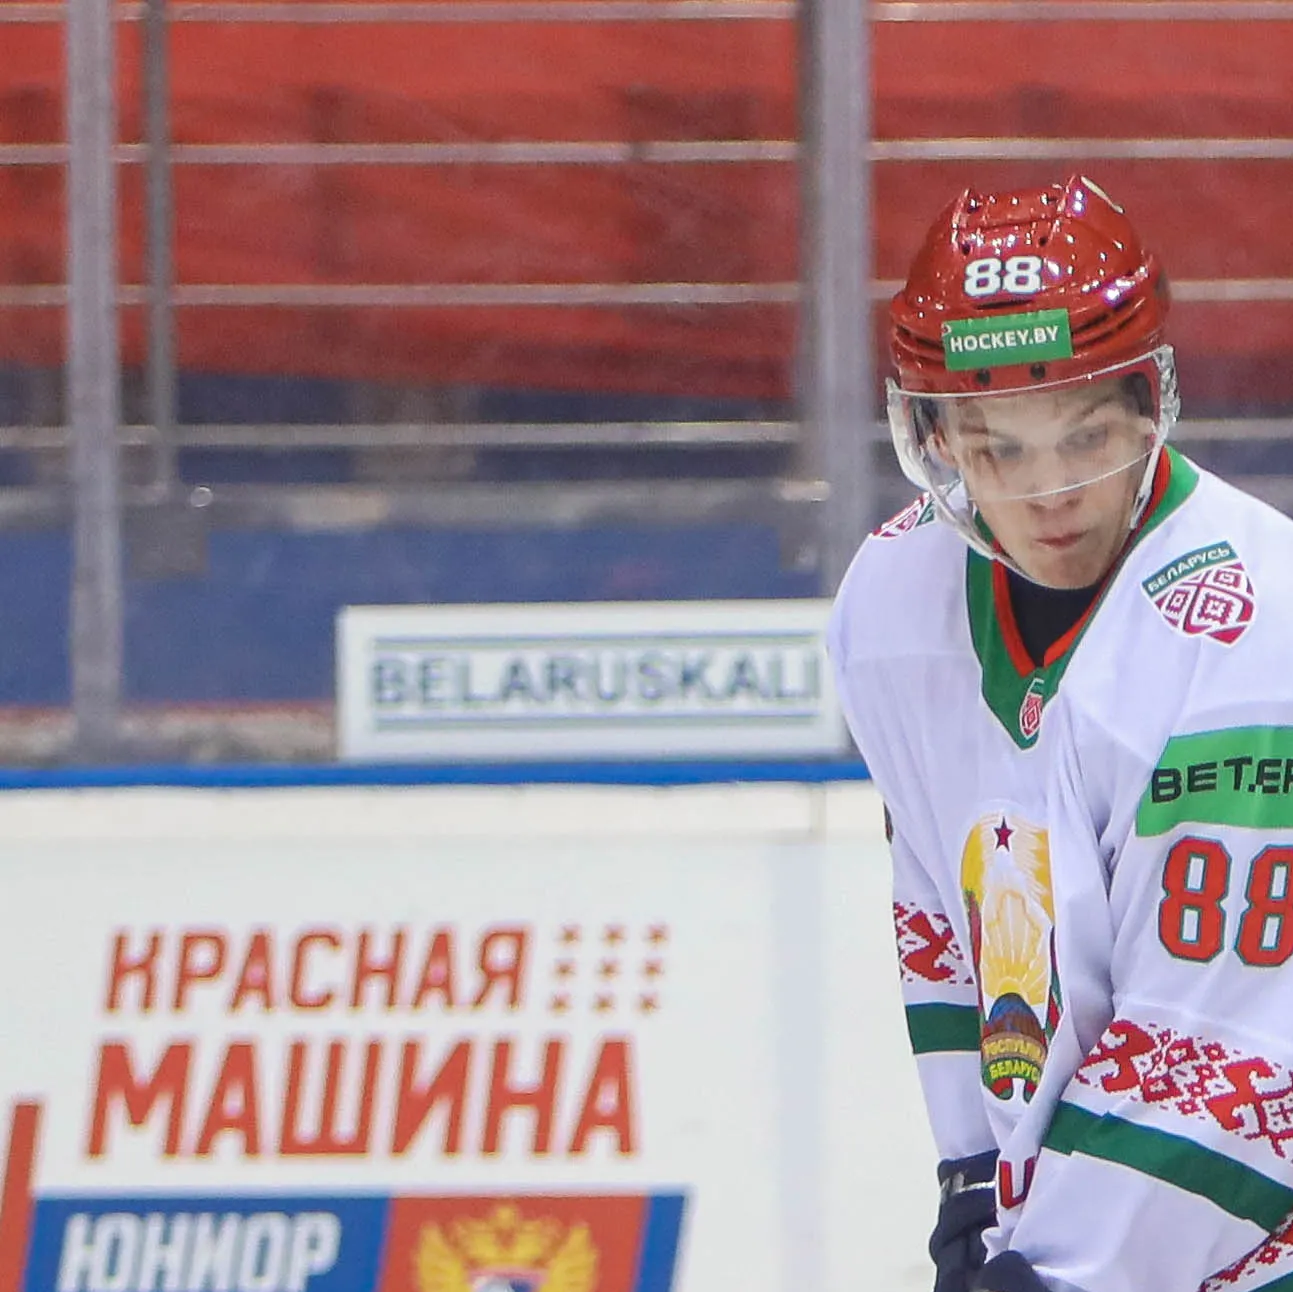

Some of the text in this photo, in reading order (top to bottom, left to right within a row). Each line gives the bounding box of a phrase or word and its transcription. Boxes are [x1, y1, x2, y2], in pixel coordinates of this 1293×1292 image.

[963, 255, 1043, 297] 88
[950, 325, 1060, 354] HOCKEY.BY
[1147, 547, 1231, 593] БЕЛАРУСЬ
[371, 648, 822, 705] BELARUSKALI
[105, 928, 530, 1012] КРАСНАЯ
[988, 1058, 1041, 1086] БЕЛАРУС
[87, 1038, 640, 1158] МАШИНА
